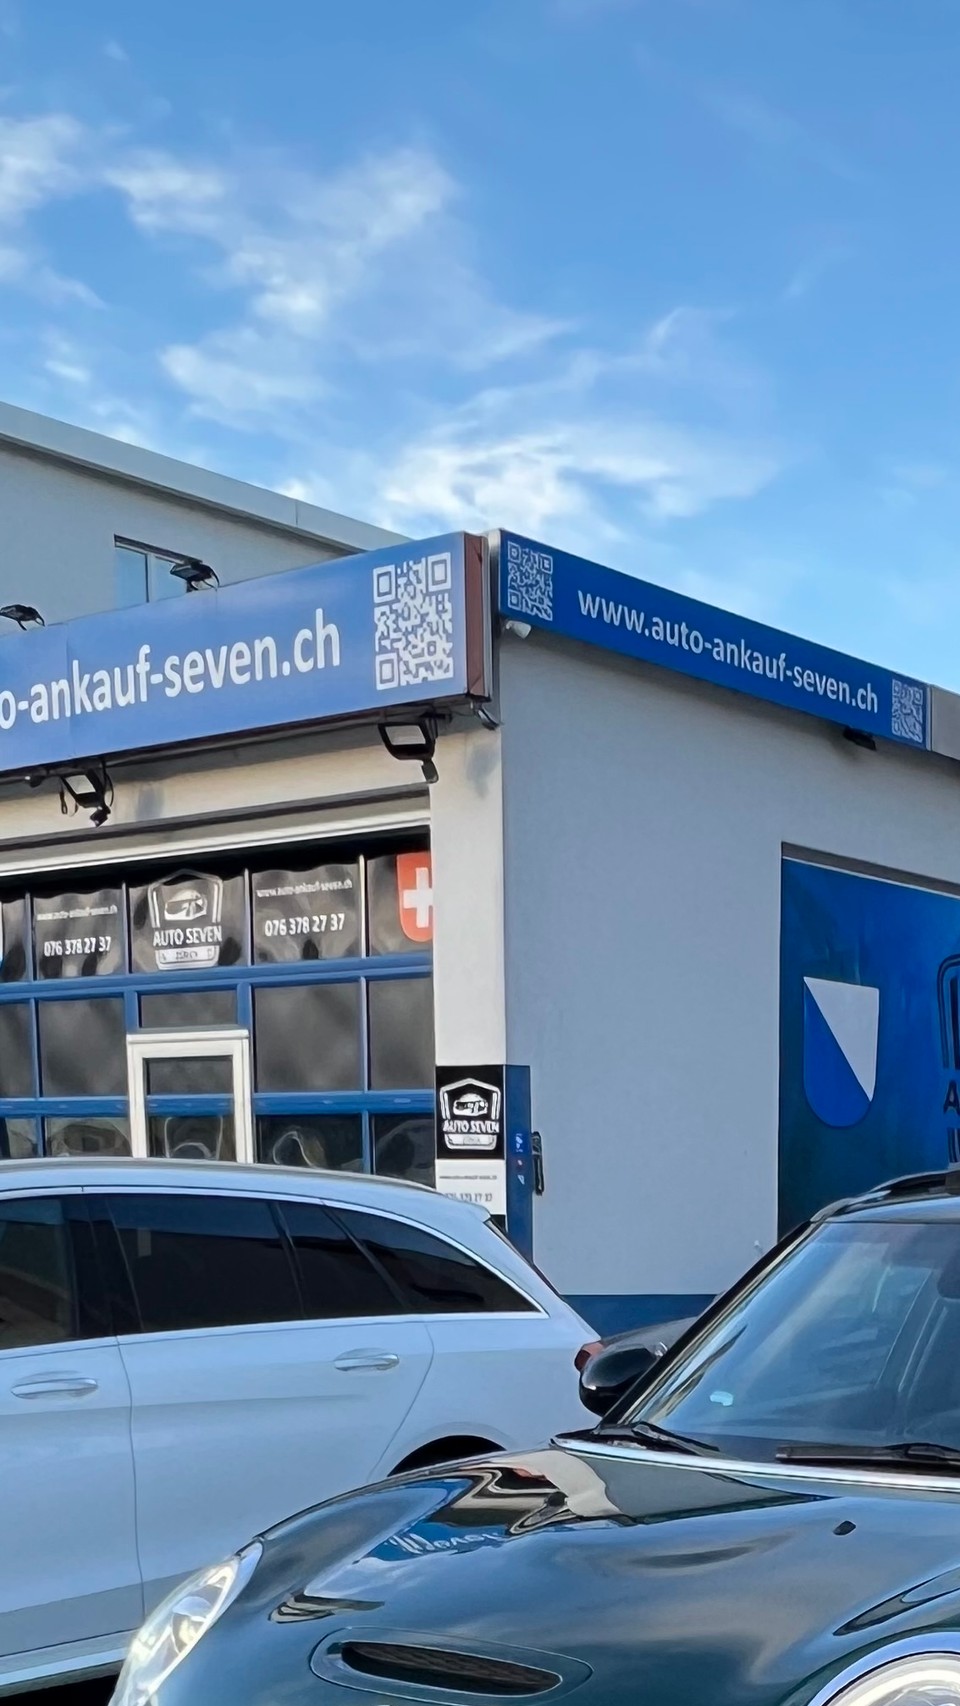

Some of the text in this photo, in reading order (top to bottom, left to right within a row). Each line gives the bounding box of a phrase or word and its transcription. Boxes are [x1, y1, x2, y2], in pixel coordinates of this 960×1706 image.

[577, 589, 878, 714] www.auto-ankauf-seven.ch
[264, 912, 346, 937] 076 378 27 37
[44, 940, 63, 957] 076
[84, 937, 97, 953] 27
[98, 936, 112, 952] 37
[153, 925, 222, 947] AUTO SEVEN
[442, 1120, 500, 1134] AUTO SEVEN
